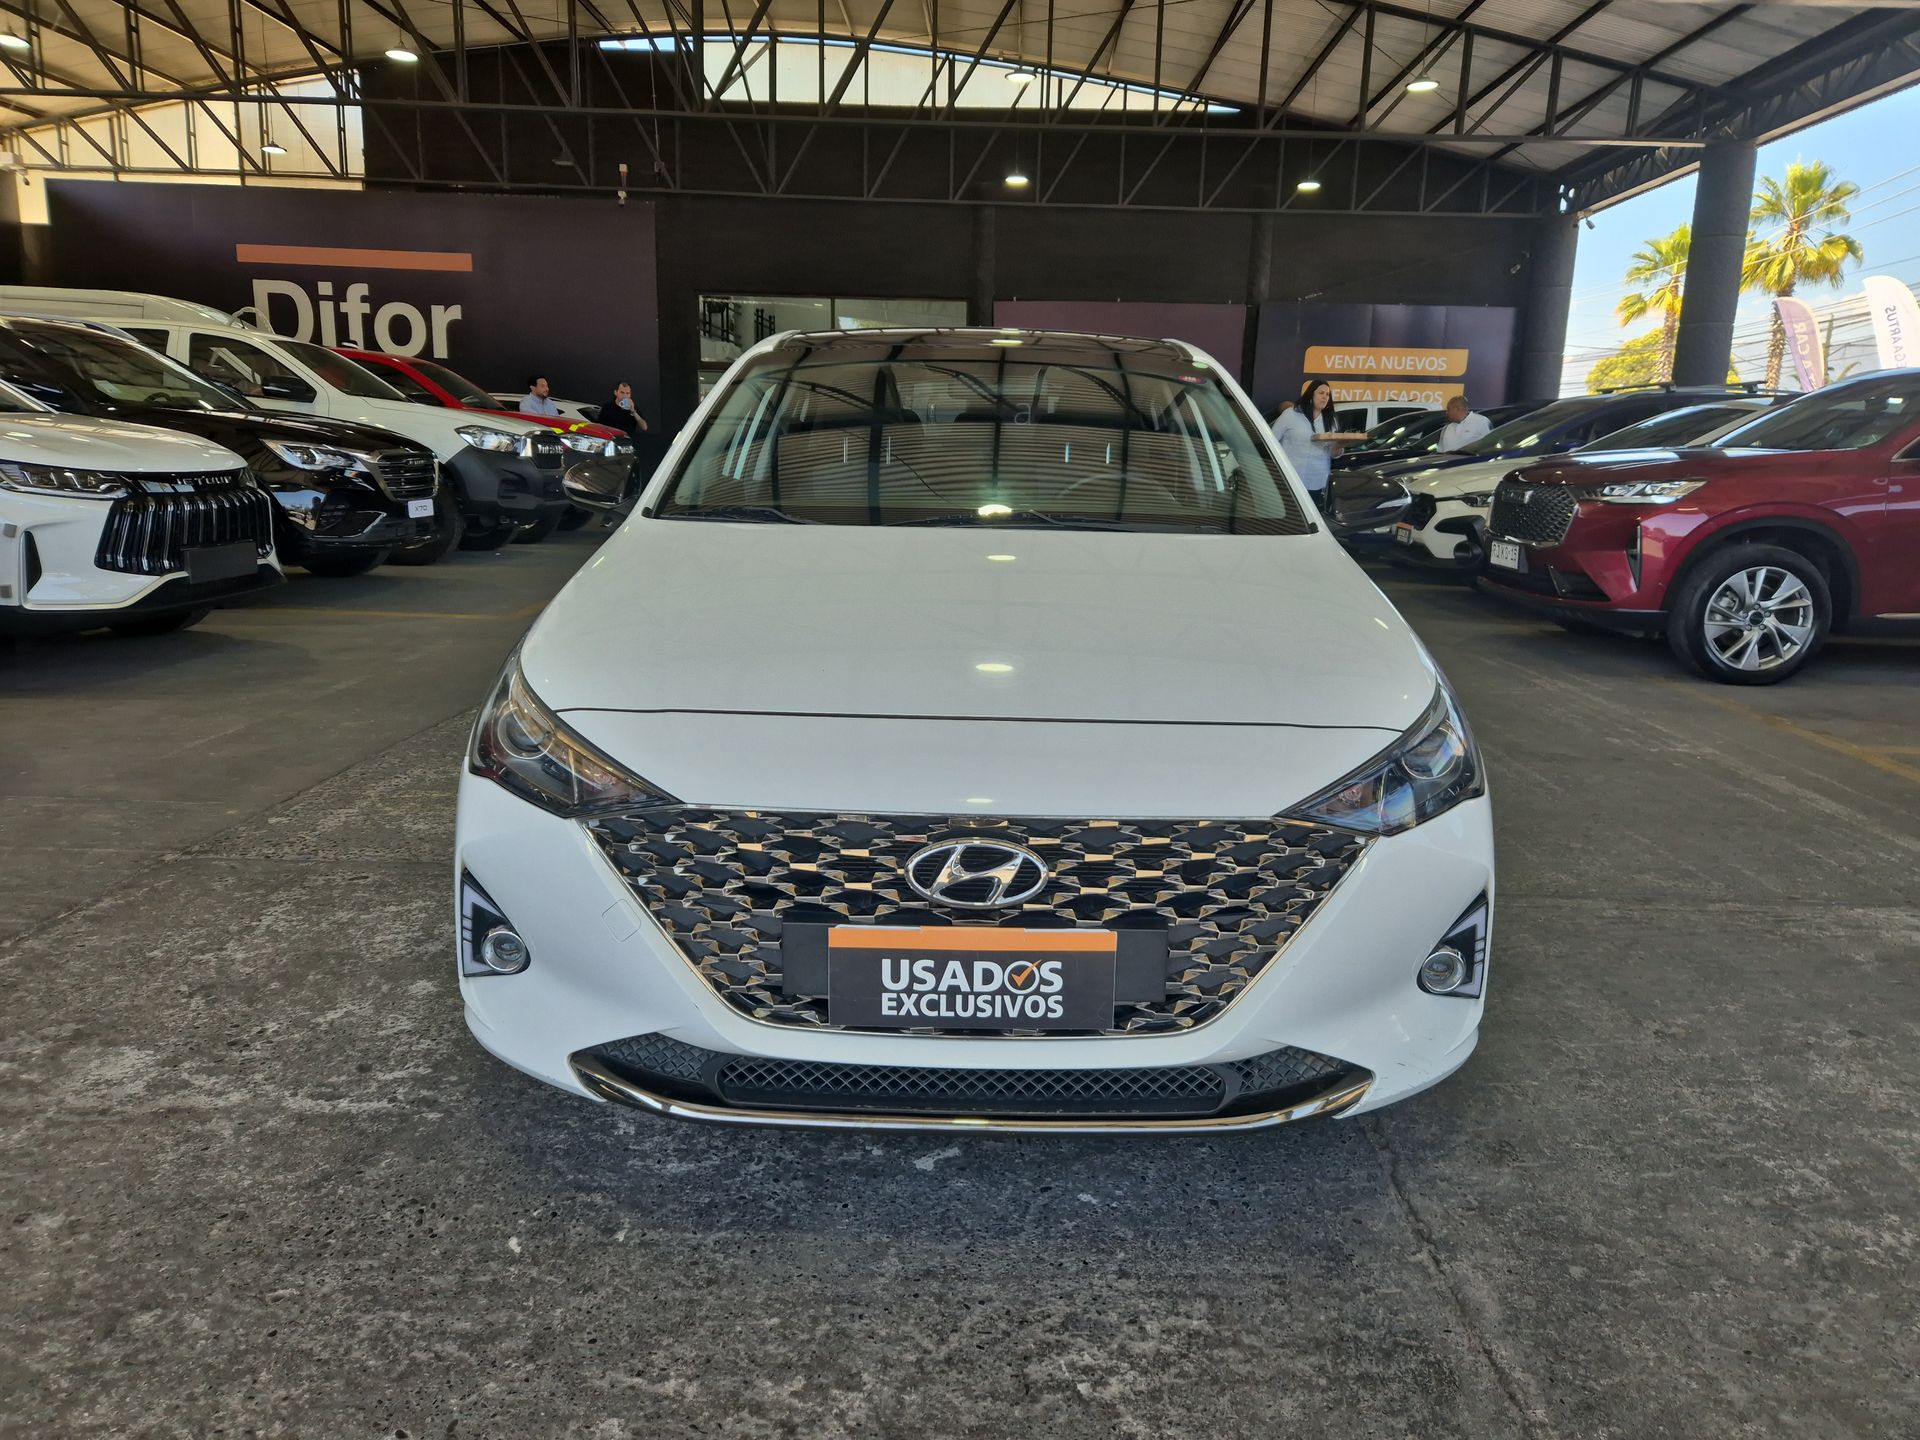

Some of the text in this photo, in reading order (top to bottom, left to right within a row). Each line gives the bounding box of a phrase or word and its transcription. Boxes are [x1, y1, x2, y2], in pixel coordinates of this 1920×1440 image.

[252, 278, 462, 359] Difor
[1324, 354, 1448, 371] VENTA NUEVOS
[1331, 389, 1372, 401] ENTA
[881, 958, 1064, 995] USADOS
[881, 993, 1064, 1018] EXCLUSIVOS
